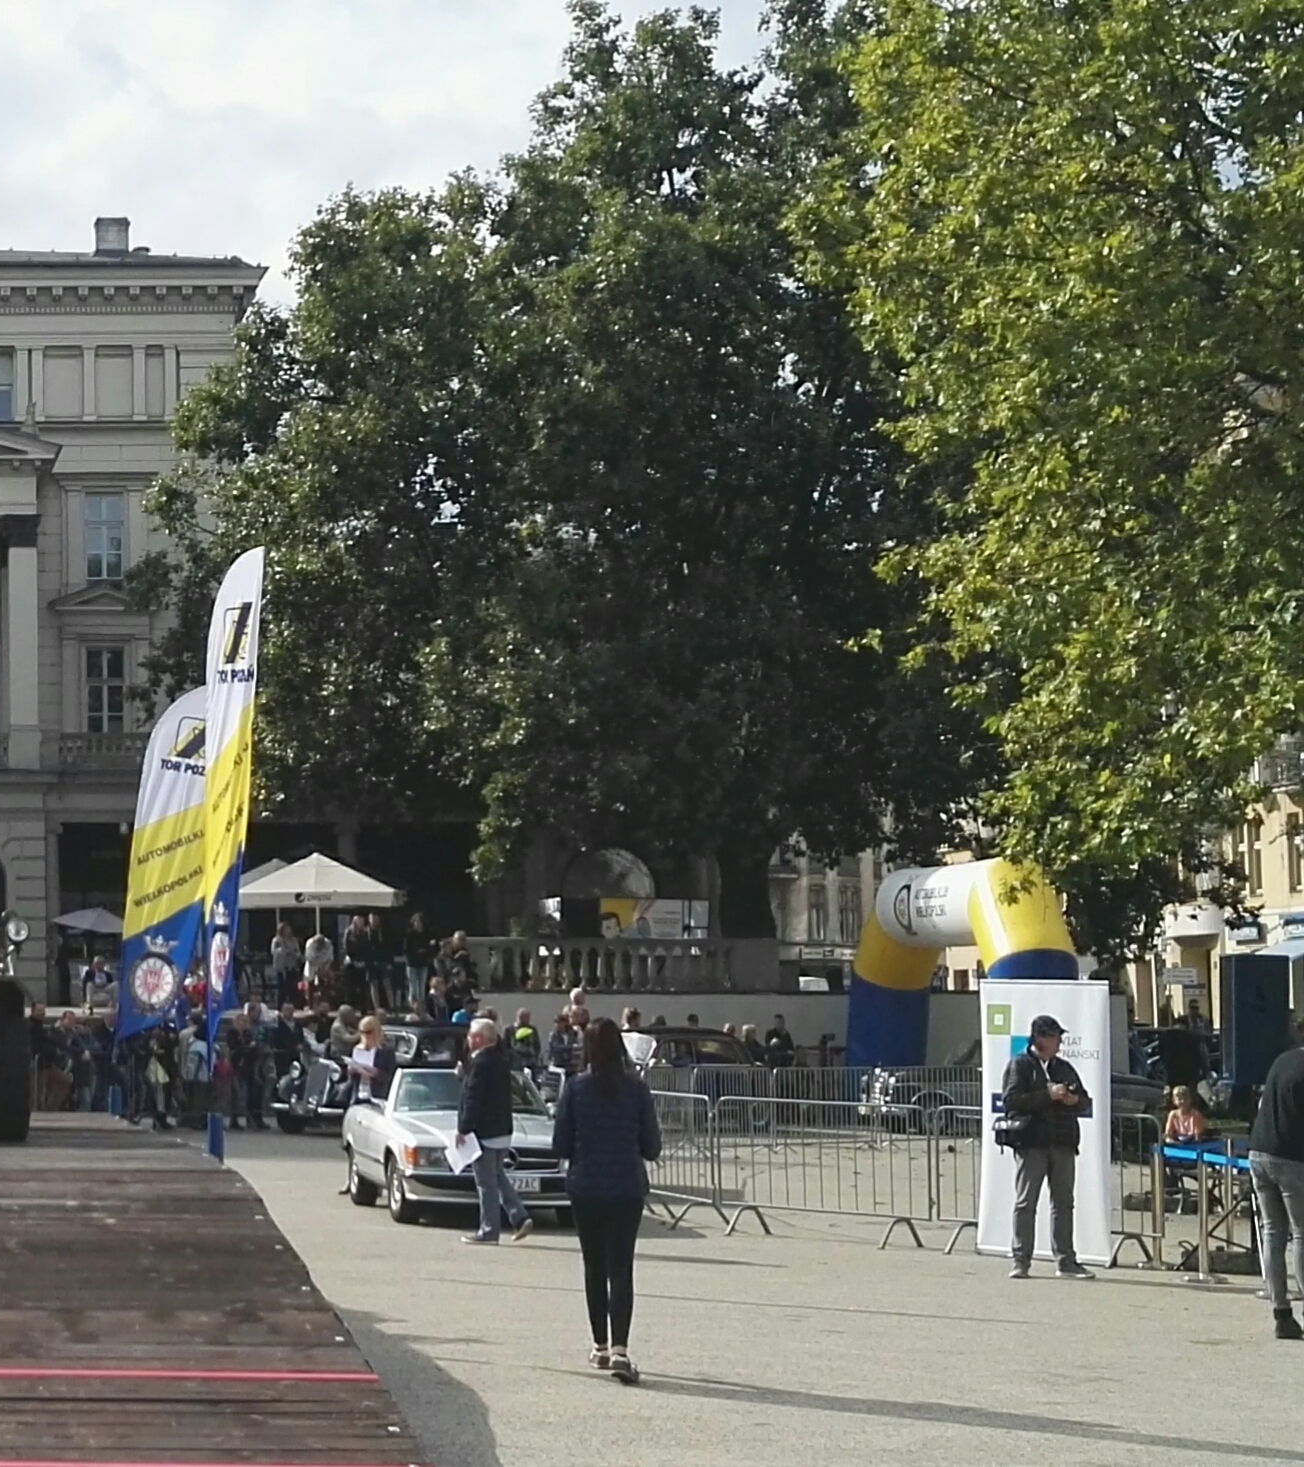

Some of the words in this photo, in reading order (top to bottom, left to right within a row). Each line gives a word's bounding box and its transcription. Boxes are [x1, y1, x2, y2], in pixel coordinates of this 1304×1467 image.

[161, 758, 182, 772] TOR
[184, 763, 206, 777] POZ
[136, 829, 205, 866] AUTOMOBILKL
